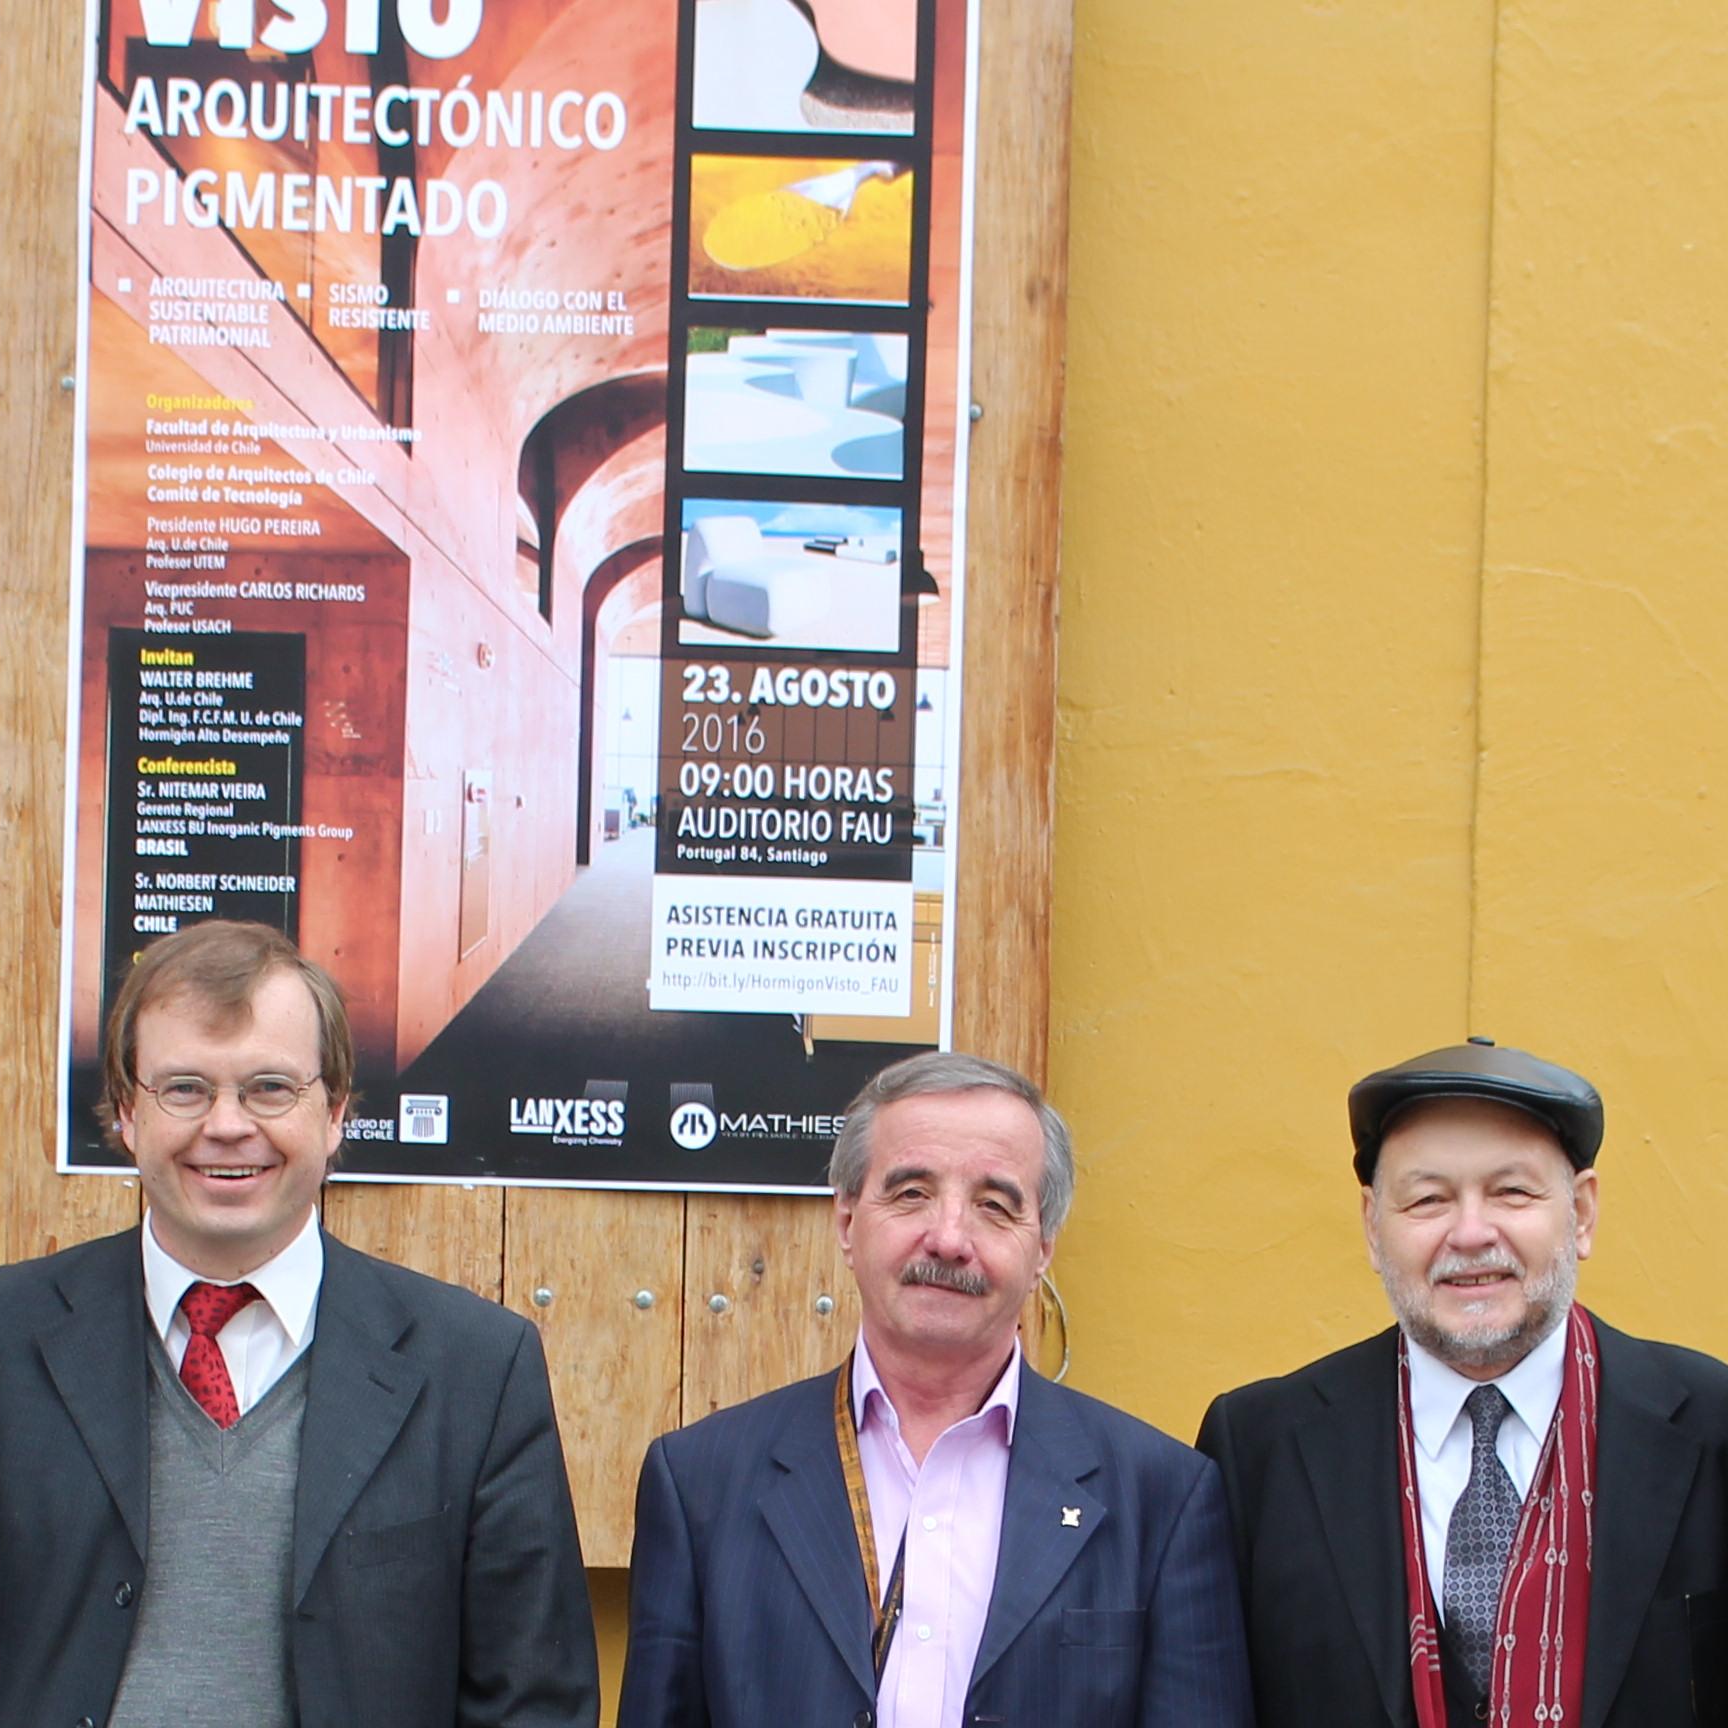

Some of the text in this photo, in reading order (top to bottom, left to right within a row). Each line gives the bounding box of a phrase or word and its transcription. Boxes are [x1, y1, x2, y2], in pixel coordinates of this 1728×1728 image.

[124, 76, 627, 150] ARQUITECTÓNICO
[125, 168, 508, 239] PIGMENTADO
[148, 279, 285, 301] ARQUITECTURA
[328, 284, 388, 305] SISMO
[478, 286, 627, 311] DIÁLOGO CON EL
[148, 302, 269, 324] SUSTENTABLE
[328, 307, 430, 330] RESISTENTE
[478, 313, 634, 336] MEDIO AMBIENTE
[148, 325, 271, 348] PATRIMONIAL
[146, 419, 422, 443] Facultad de Arquitectura y Urbanismo
[145, 440, 261, 456] Universidad de Chile
[147, 464, 376, 486] Colegio de Arquitectos de Chile
[147, 486, 303, 509] Comité de Tecnología
[147, 516, 321, 536] Presidente HUGO PEREIRA
[199, 538, 229, 552] Chile
[146, 555, 225, 570] Profesor UTEM
[144, 580, 365, 602] Vicepresidente CARLOS RICHARDS
[144, 619, 232, 635] Profesor USACH
[140, 648, 194, 666] Invitan
[139, 671, 254, 690] WALTER BREHME
[682, 665, 897, 710] 23. AGOSTO
[139, 692, 163, 709] Arq.
[193, 692, 223, 707] Chile
[139, 709, 166, 725] Dipl.
[168, 710, 191, 728] Ing.
[240, 711, 254, 726] U.
[255, 712, 270, 727] de
[272, 712, 303, 727] Chile
[138, 727, 290, 747] Hormigón Alto Desempeño
[681, 712, 766, 754] 2016
[137, 757, 236, 776] Conferencista
[137, 781, 266, 800] Sr. NITEMAR VIEIRA
[679, 761, 893, 803] 09:00 HORAS
[136, 802, 234, 820] Gerente Regional
[136, 820, 353, 842] LANXESS BU Inorganic Pigments Group
[677, 806, 893, 845] AUDITORIO FAU
[135, 839, 189, 857] BRASIL
[677, 844, 828, 867] Portugal 84, Santiago
[135, 873, 297, 893] Sr. NORBERT SCHNEIDER
[134, 894, 213, 912] MATHIESEN
[133, 916, 177, 933] CHILE
[667, 904, 898, 932] ASISTENCIA GRATUITA
[666, 936, 898, 963] PREVIA INSCRIPCIÓN
[379, 1119, 395, 1130] DE
[510, 1097, 625, 1136] LANXESS
